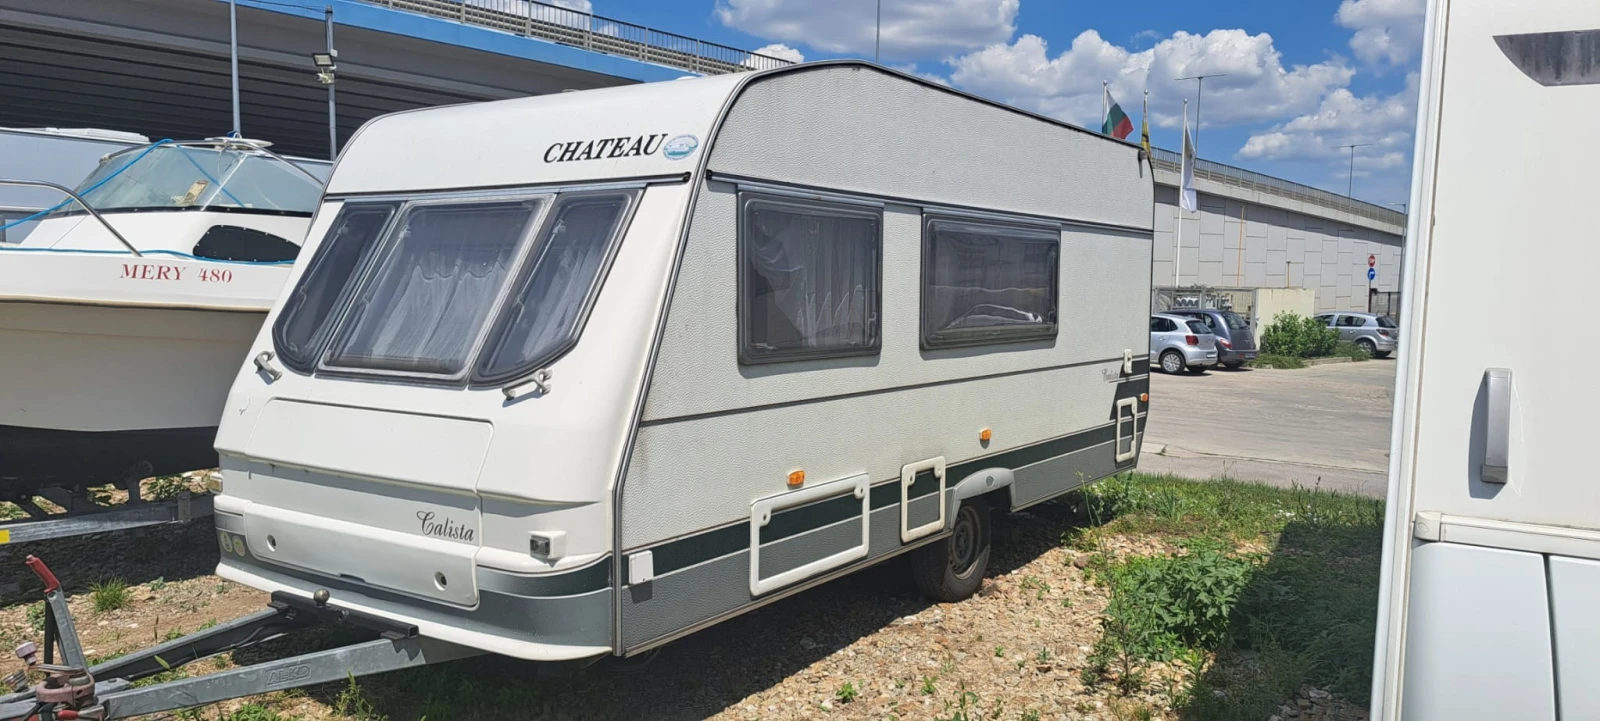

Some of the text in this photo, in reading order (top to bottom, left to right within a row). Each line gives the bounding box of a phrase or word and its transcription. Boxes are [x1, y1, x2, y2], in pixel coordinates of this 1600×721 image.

[543, 133, 668, 163] CHATEAU
[120, 264, 232, 284] MERY 480
[416, 510, 474, 542] Calista
